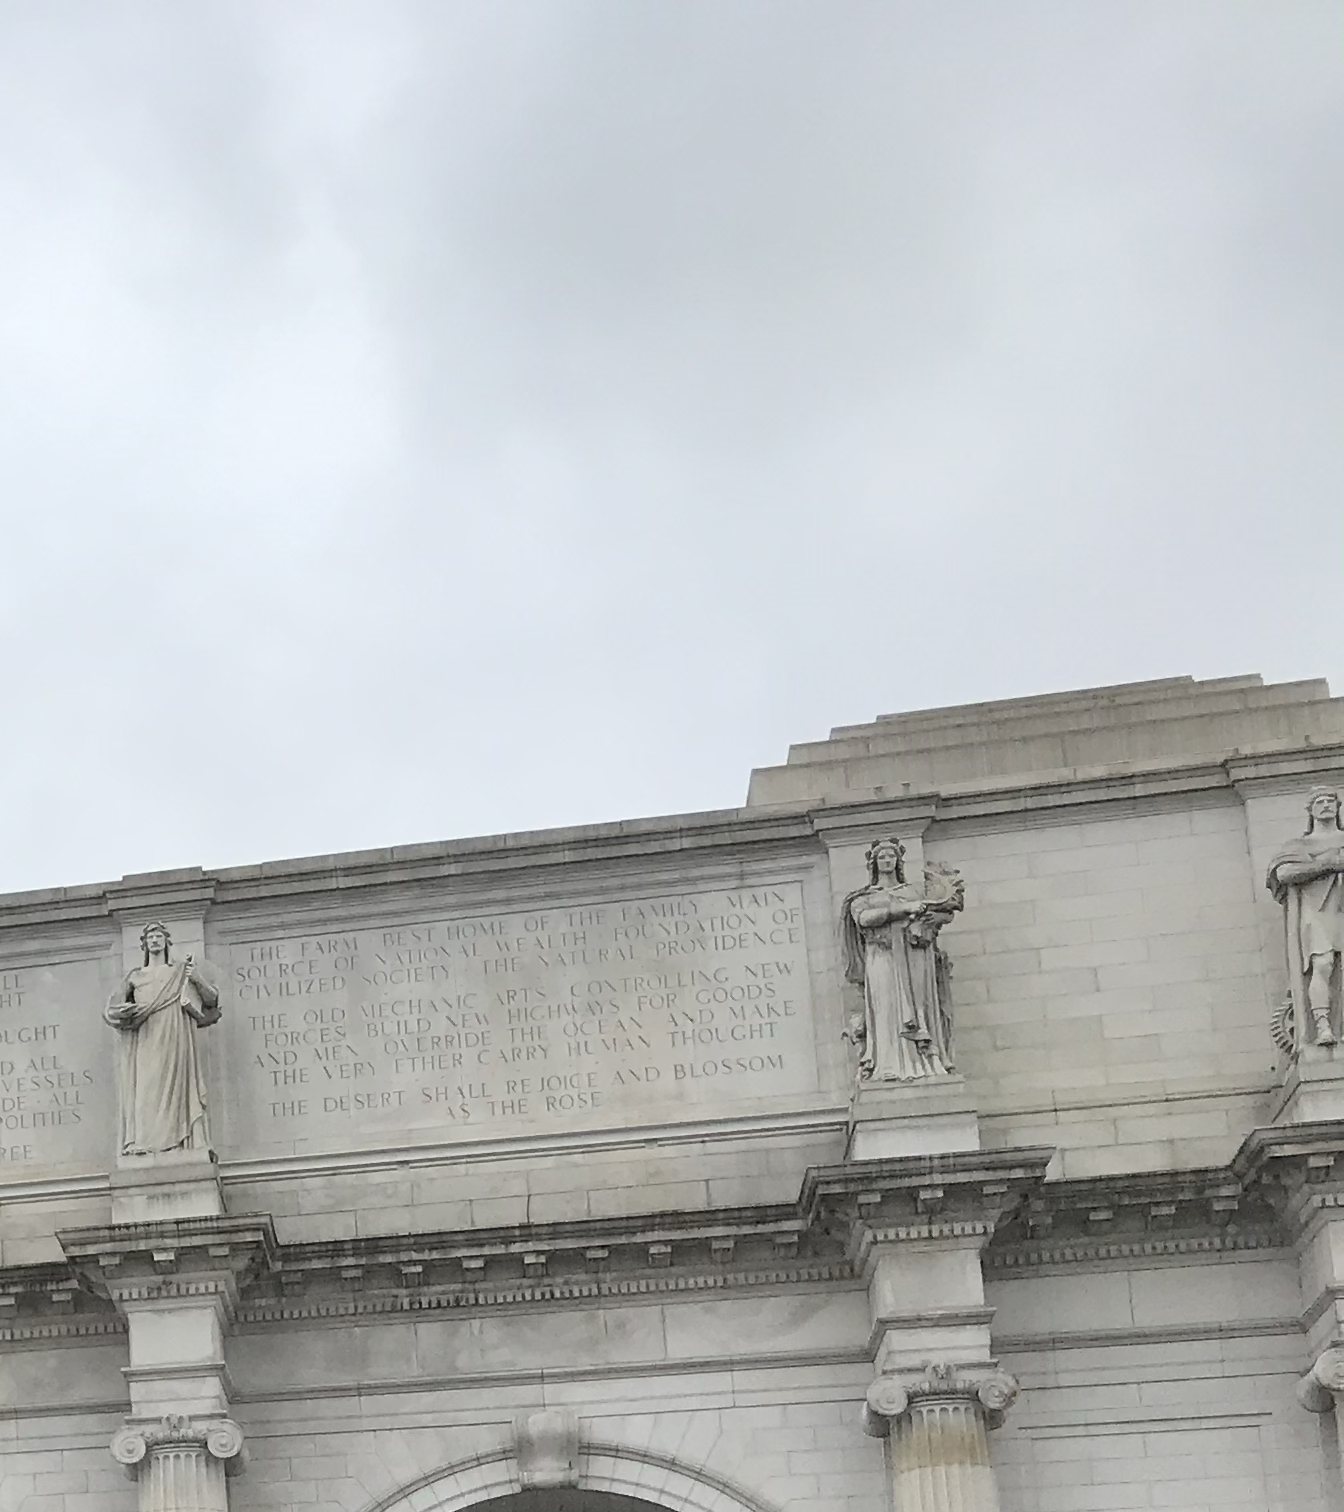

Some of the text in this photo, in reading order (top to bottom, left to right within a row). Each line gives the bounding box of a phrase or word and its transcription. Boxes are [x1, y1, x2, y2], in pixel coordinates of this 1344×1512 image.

[771, 907, 799, 924] OF
[250, 945, 286, 962] THE
[382, 927, 434, 947] BEST
[523, 915, 549, 932] OF
[569, 910, 605, 927] THE
[483, 956, 520, 975] THE
[247, 960, 794, 1030] THE OLD NEW
[254, 1050, 297, 1067] AND
[506, 1025, 547, 1043] THE
[667, 1008, 714, 1026] AND
[722, 1000, 795, 1020] MAKE
[264, 981, 775, 1048] FORCES FOR GOODS
[24, 1055, 62, 1072] ALL
[269, 1021, 776, 1086] THE CARRY THOUGHT
[1, 1069, 93, 1092] VESSELS
[49, 1090, 84, 1106] ALL
[268, 1054, 783, 1117] THE DESERT SHALL REJOICE AND BLOSSOM
[486, 1091, 601, 1116] THE ROSE
